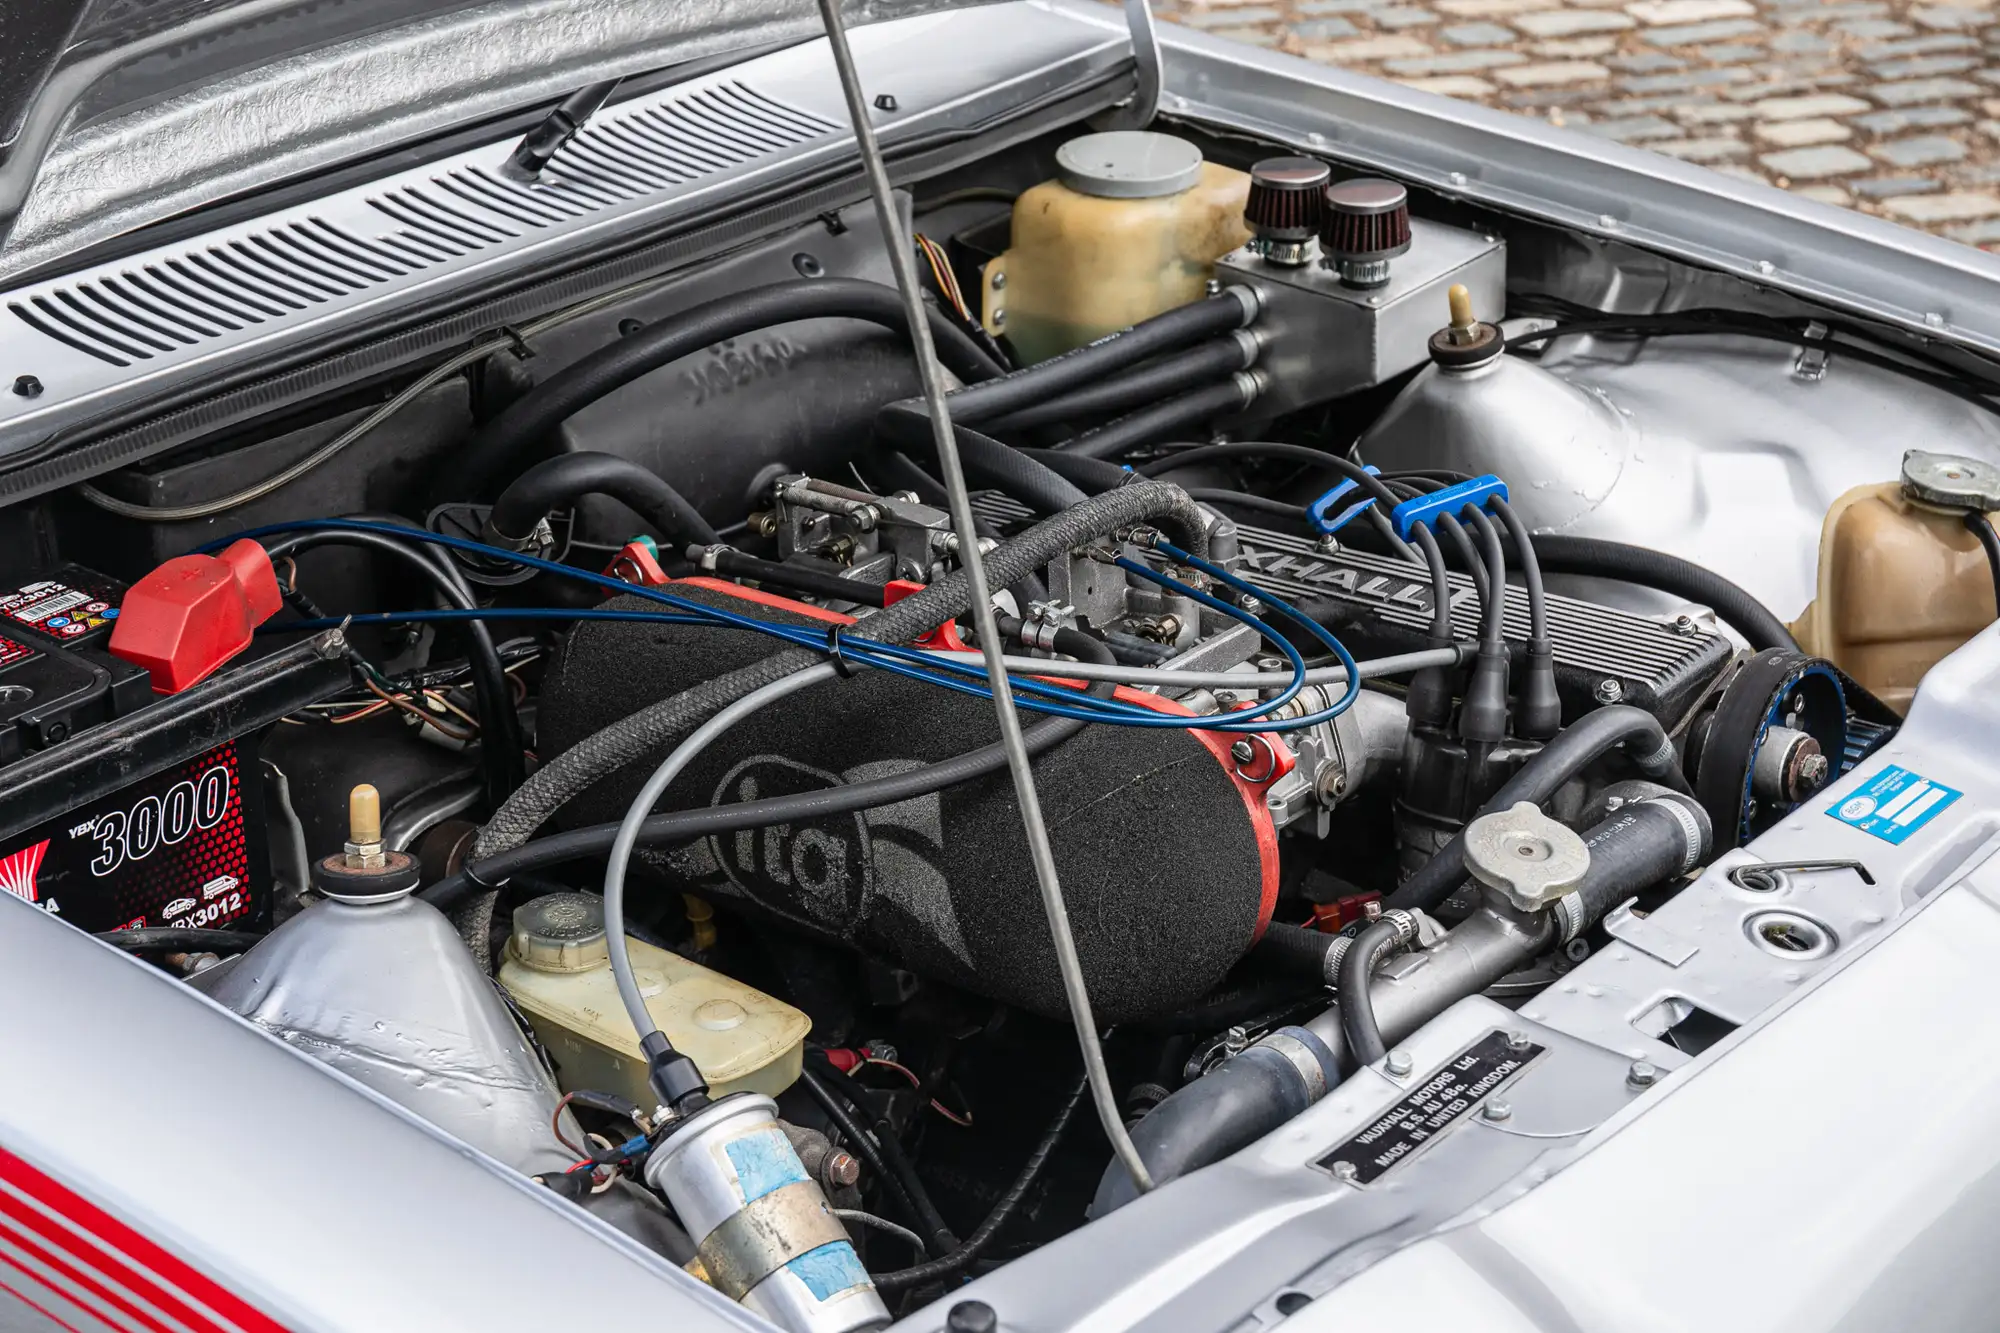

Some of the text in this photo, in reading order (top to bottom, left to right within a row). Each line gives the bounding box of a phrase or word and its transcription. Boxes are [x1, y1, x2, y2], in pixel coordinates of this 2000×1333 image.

[1237, 544, 1427, 611] XHALL
[91, 765, 230, 877] 3000
[1355, 1055, 1480, 1145] VAUXHALL MOTORS Ltd.
[1374, 1060, 1522, 1167] MADE IN UNITED KINGDOM.
[1400, 1112, 1428, 1131] B.S.
[1423, 1101, 1443, 1116] AU
